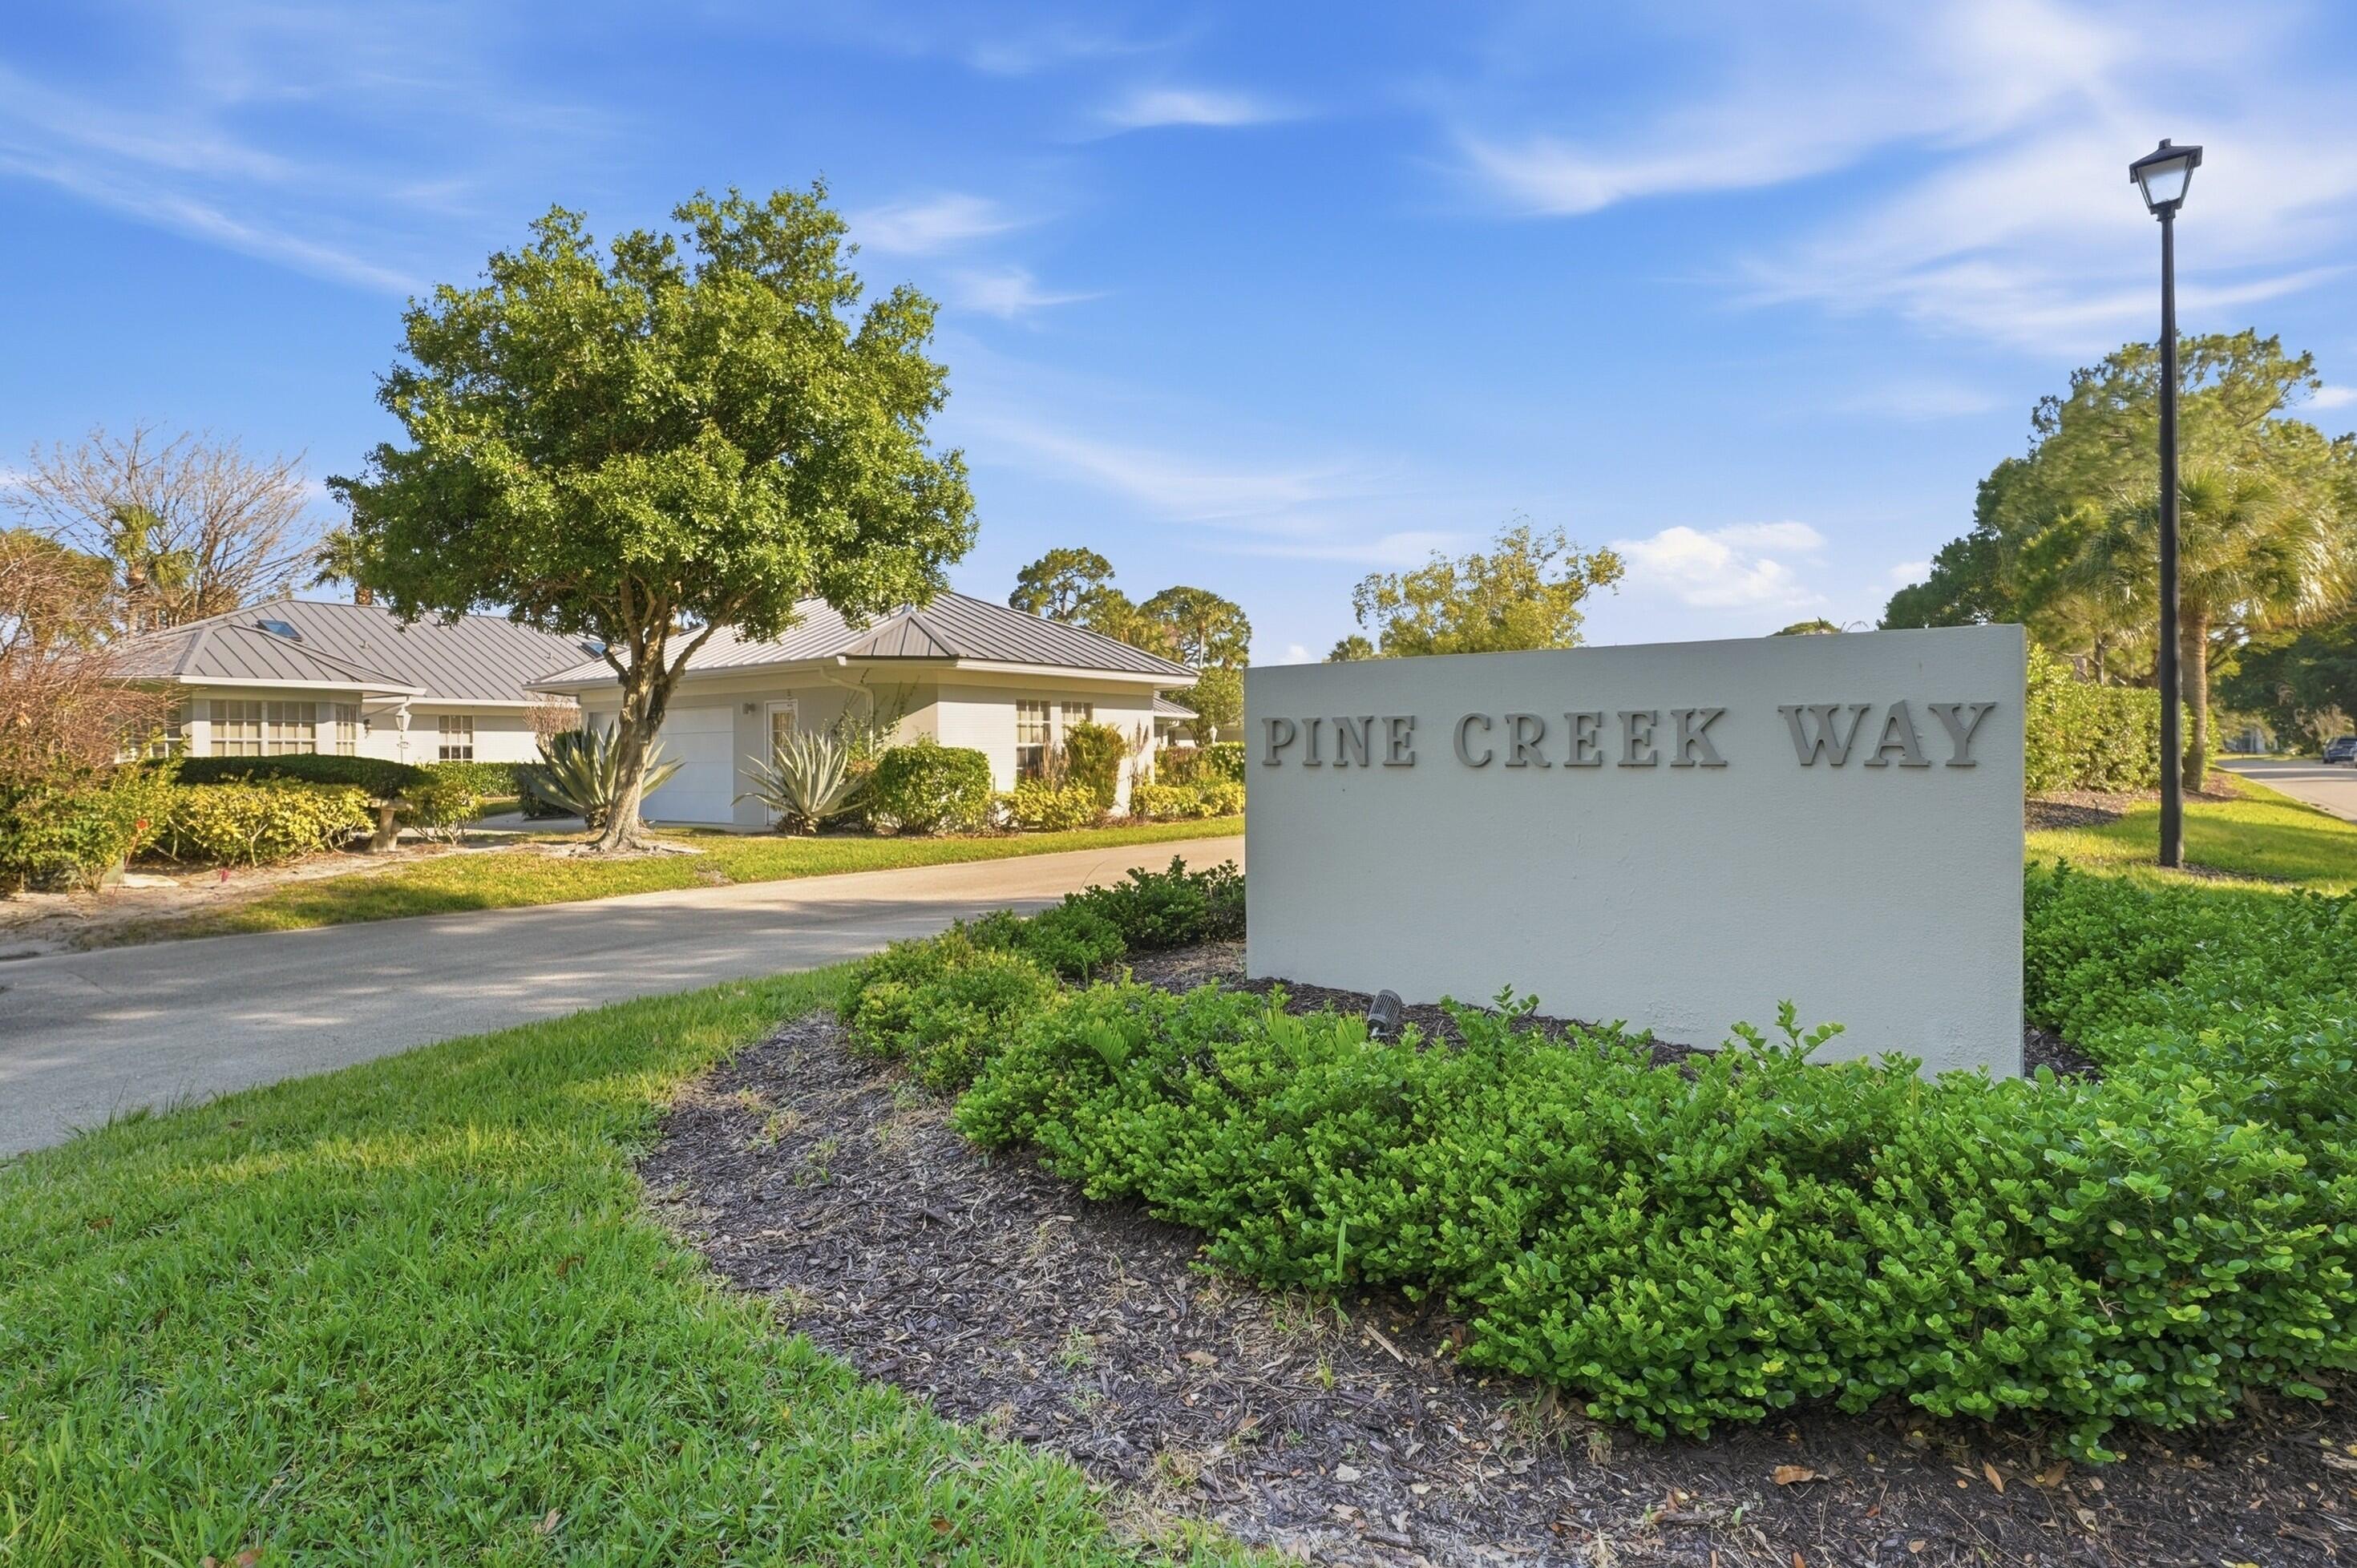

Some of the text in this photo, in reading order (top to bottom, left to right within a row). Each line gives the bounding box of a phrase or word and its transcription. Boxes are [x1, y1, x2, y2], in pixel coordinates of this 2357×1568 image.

[1262, 699, 1999, 768] PINE CREEK WAY
